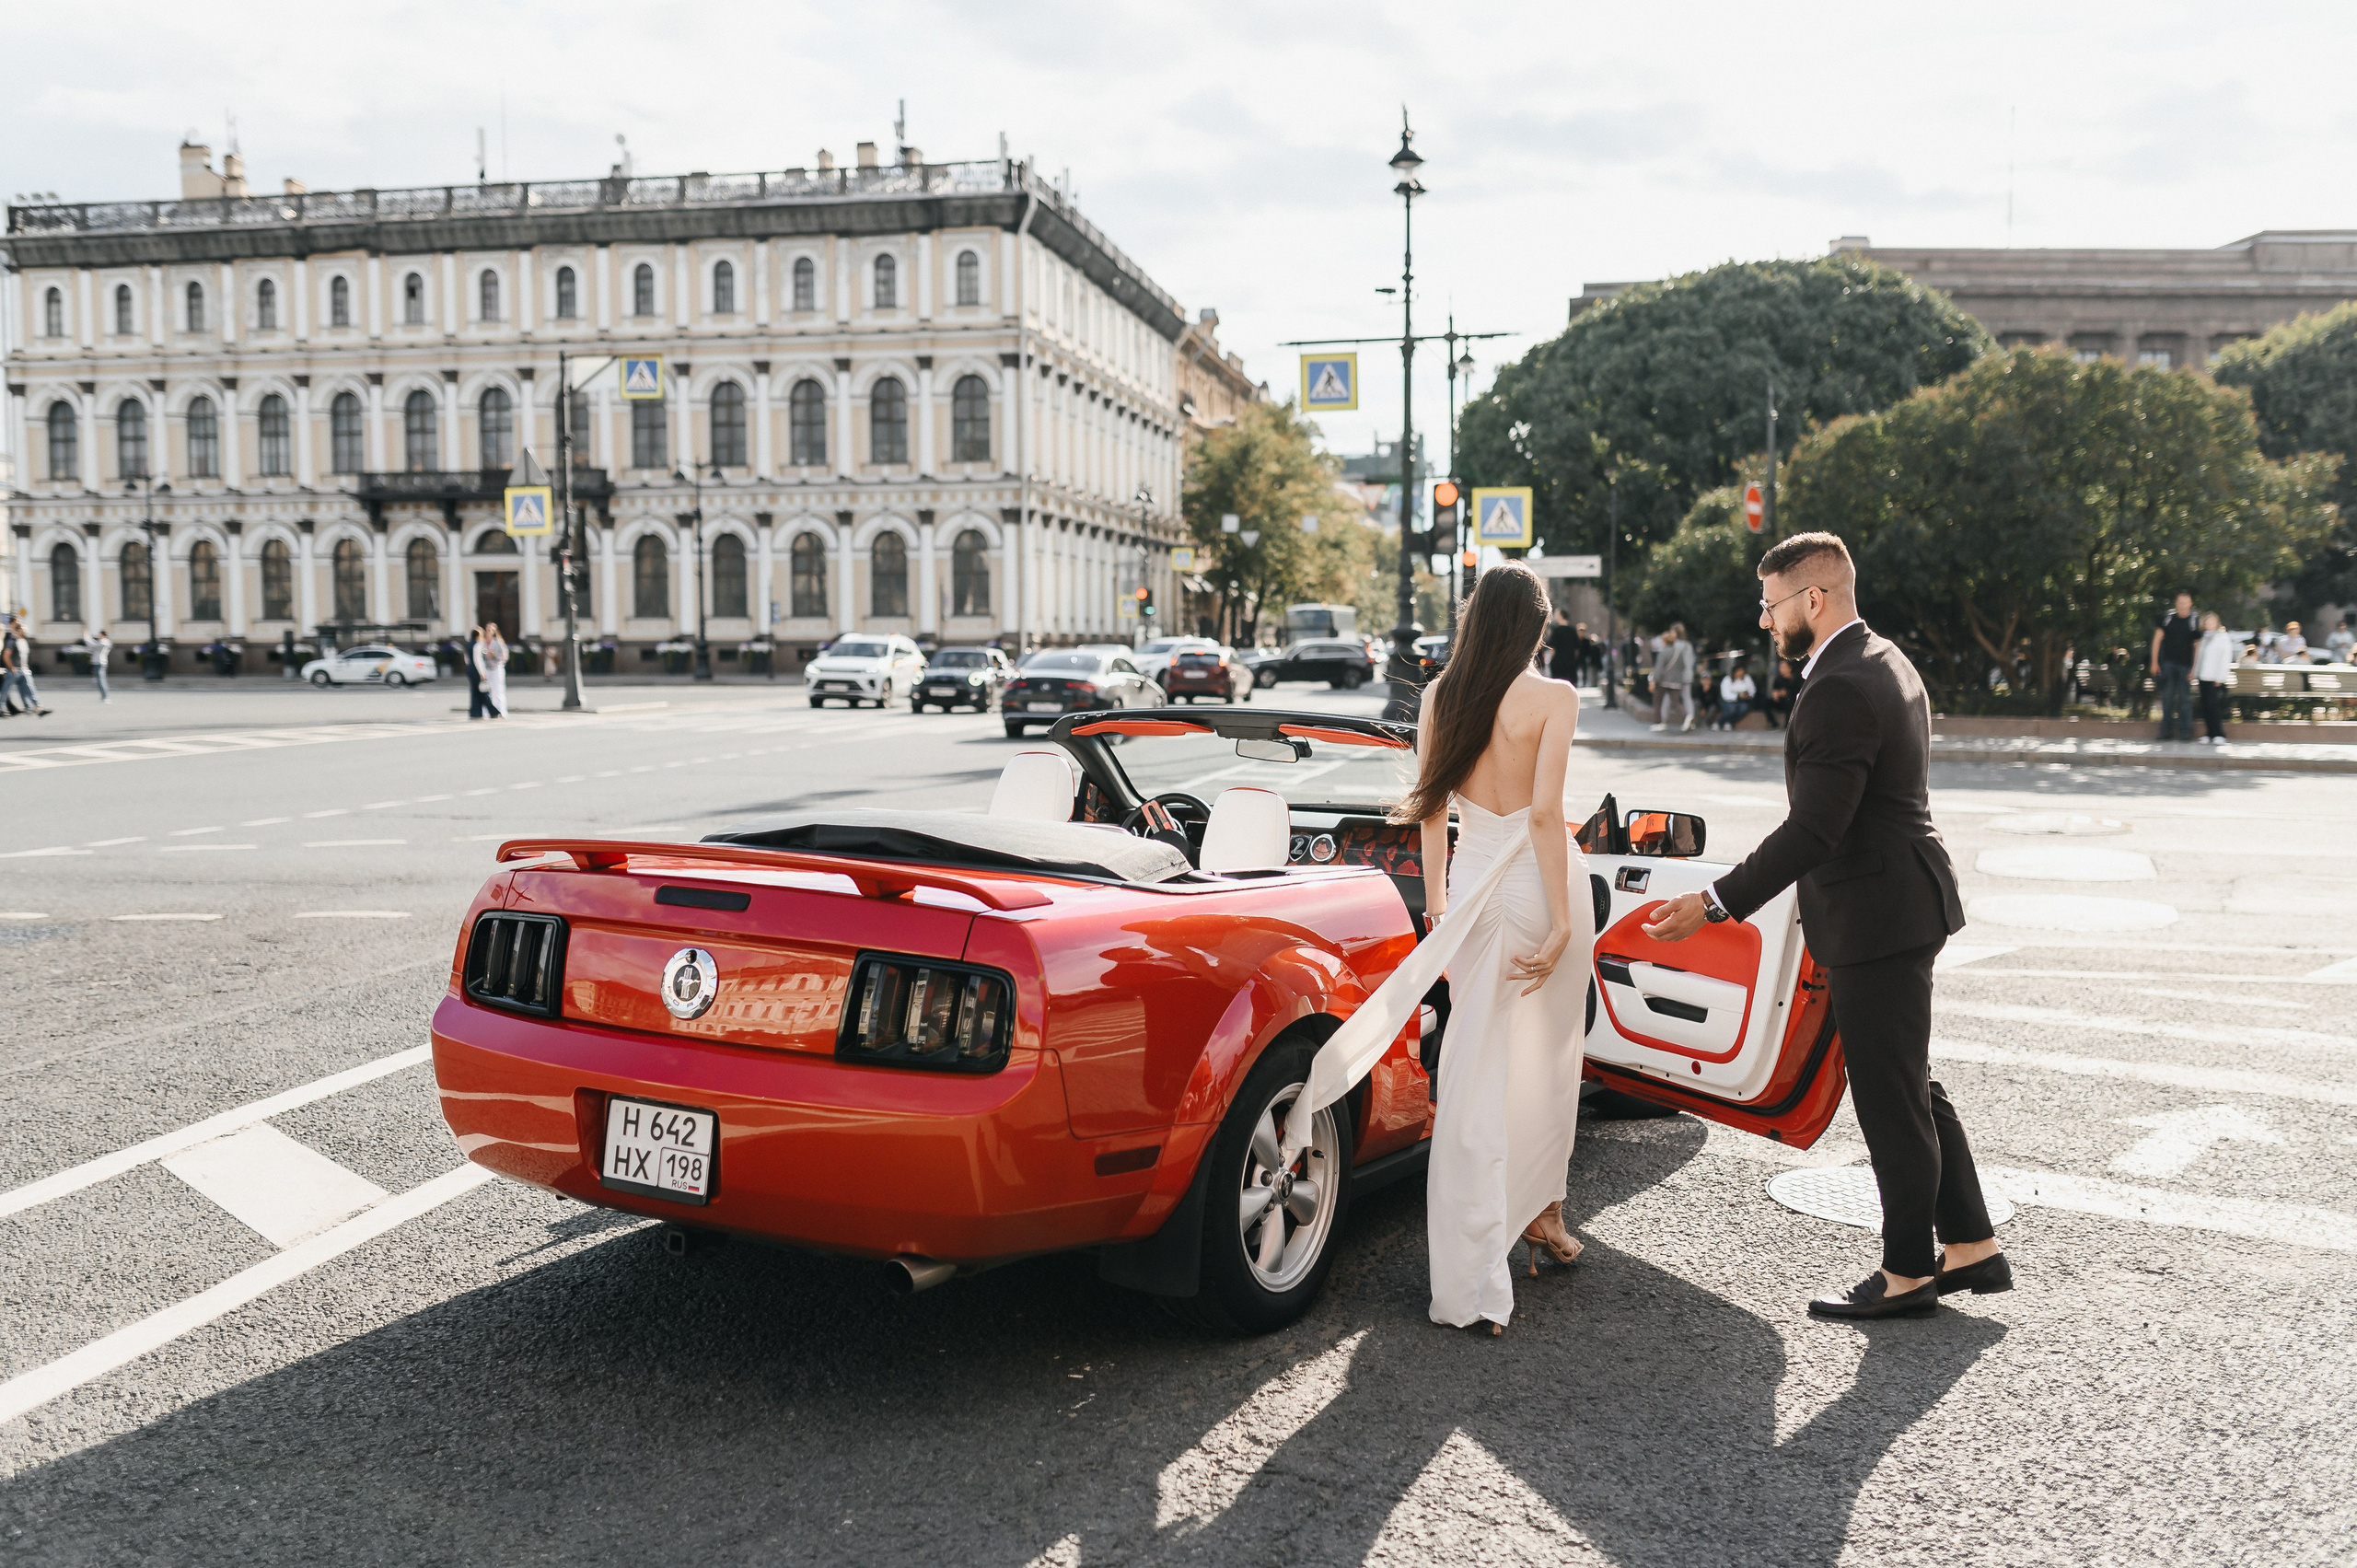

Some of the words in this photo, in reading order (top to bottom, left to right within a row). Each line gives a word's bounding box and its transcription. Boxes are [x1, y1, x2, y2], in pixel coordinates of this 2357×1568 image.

[650, 1111, 697, 1147] 642
[667, 1154, 702, 1181] 198
[671, 1179, 688, 1191] RUS
